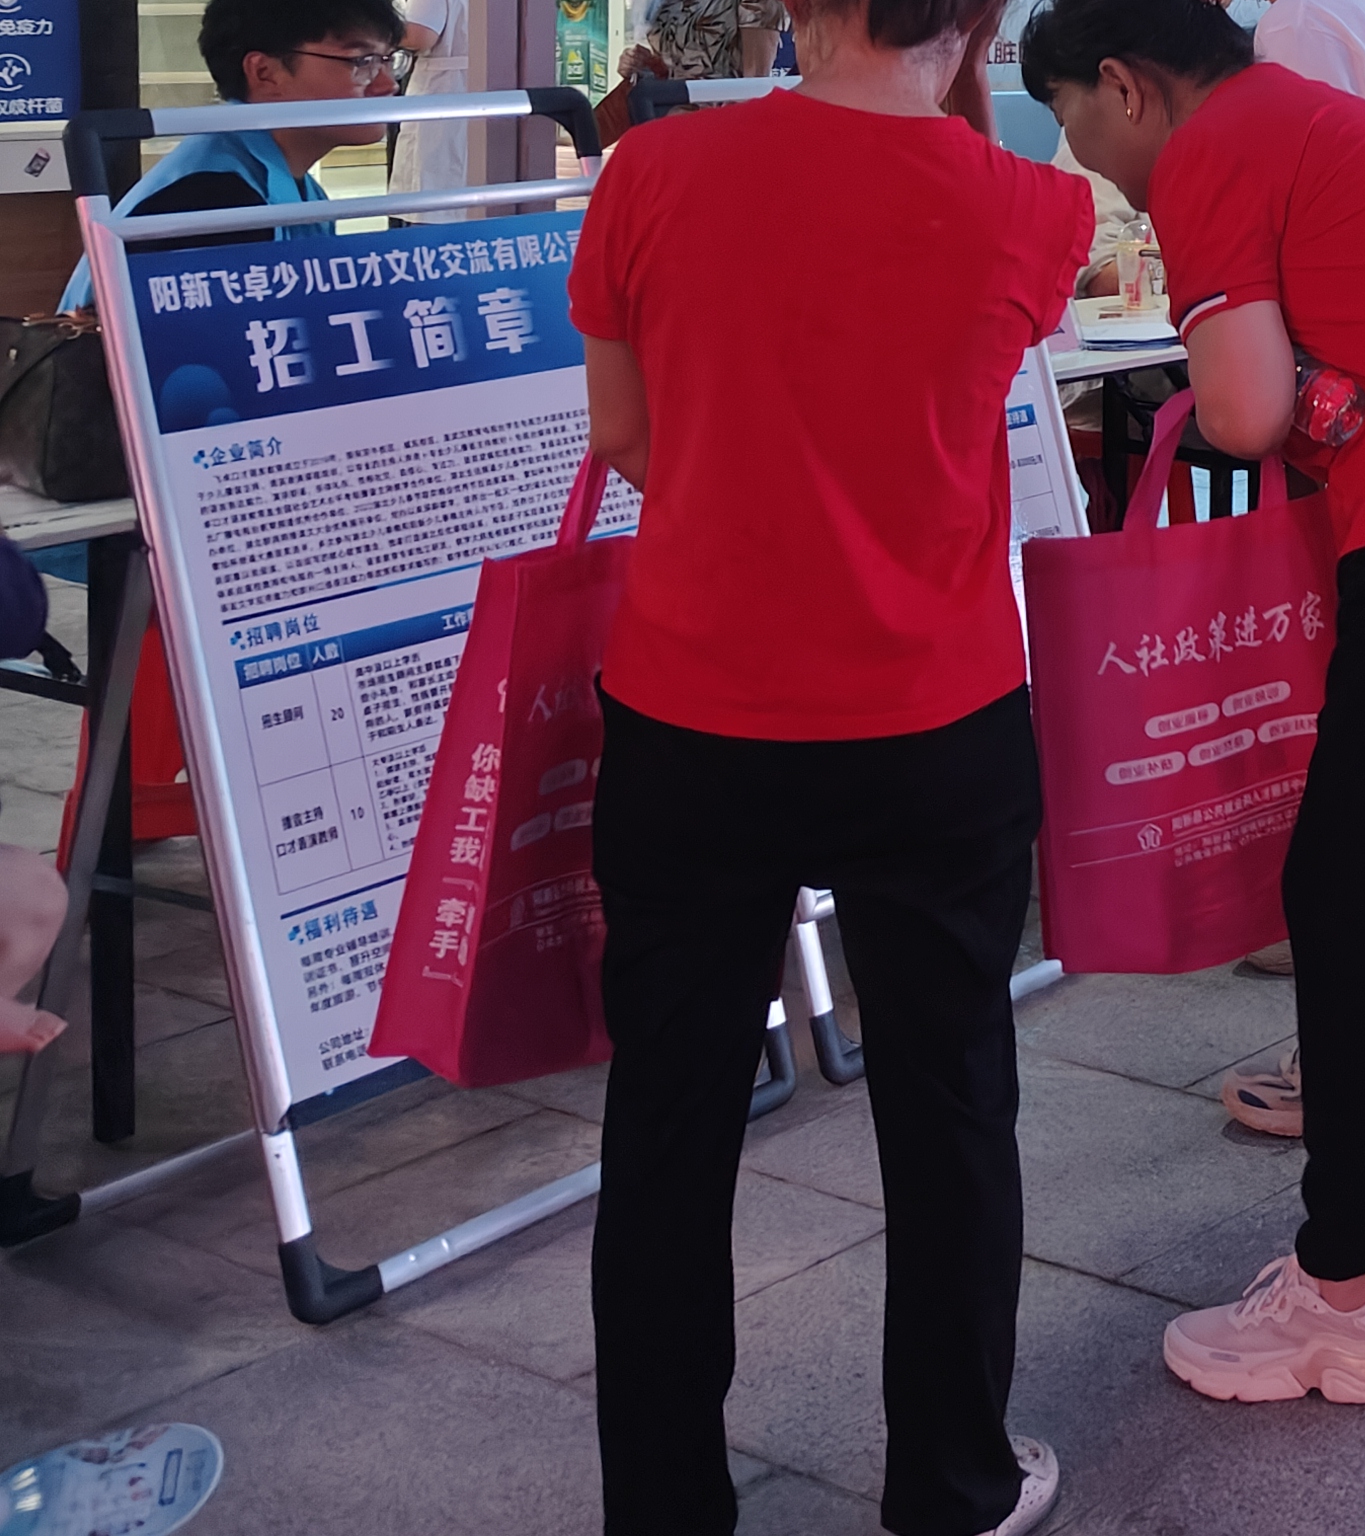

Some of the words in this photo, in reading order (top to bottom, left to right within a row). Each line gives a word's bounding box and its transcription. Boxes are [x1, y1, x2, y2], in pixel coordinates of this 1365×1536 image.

[244, 287, 541, 393] 招工简章
[208, 436, 283, 467] 企业简介
[245, 612, 322, 648] 招聘岗位
[1097, 590, 1325, 678] 人社政策进万家
[330, 706, 345, 722] 20
[350, 806, 365, 822] 10
[304, 898, 379, 942] 福利待遇
